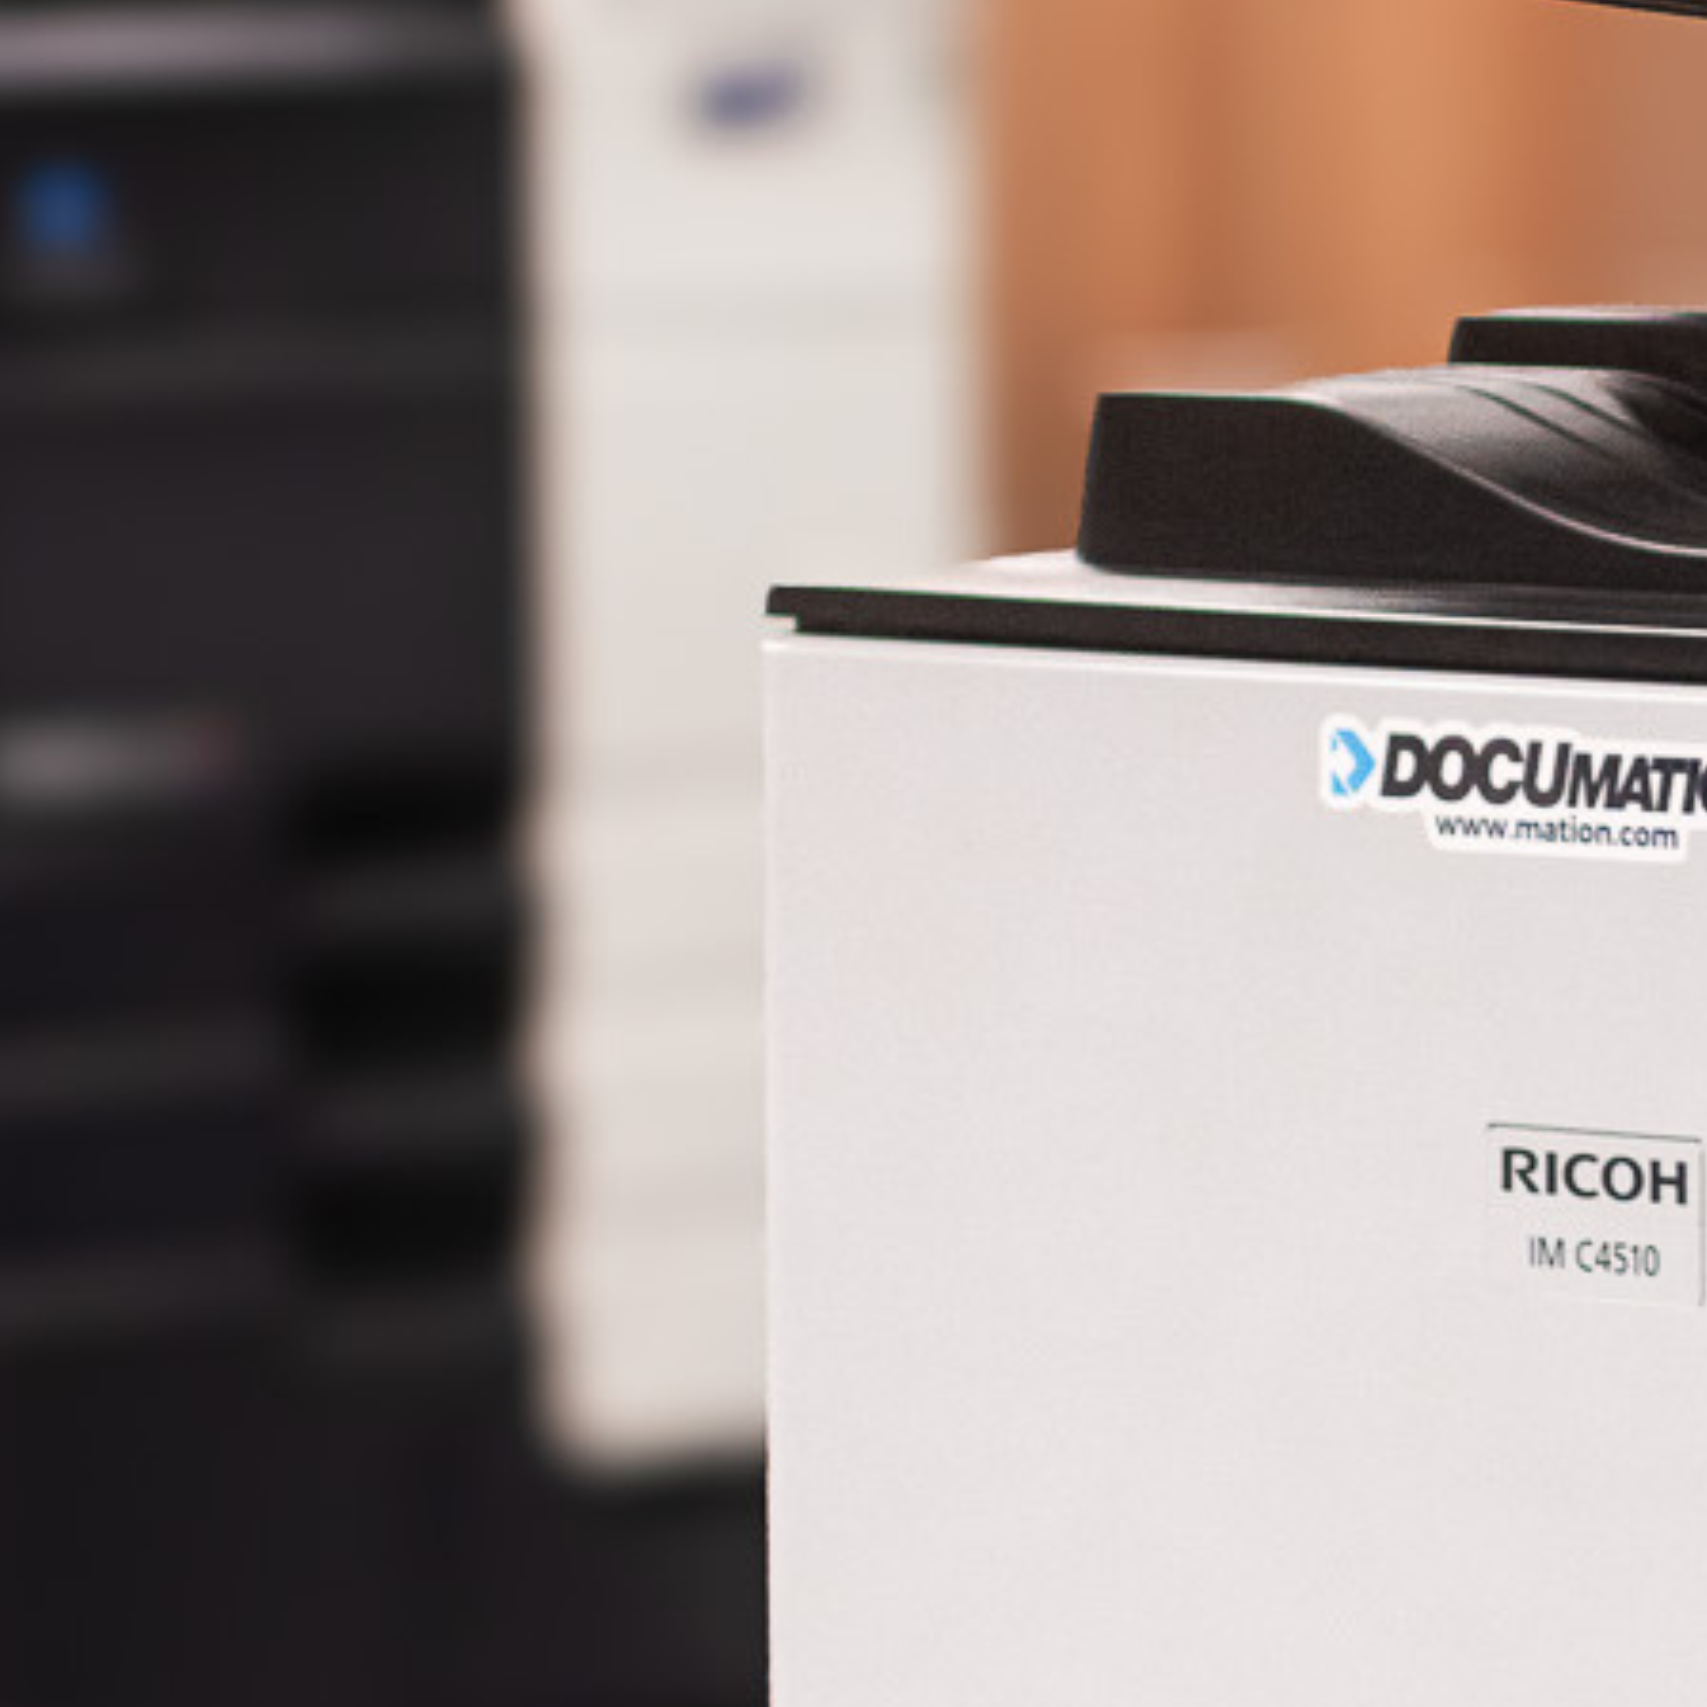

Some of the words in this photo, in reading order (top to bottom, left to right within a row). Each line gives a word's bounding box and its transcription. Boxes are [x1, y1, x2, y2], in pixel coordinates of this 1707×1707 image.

[1434, 814, 1679, 849] www.mation.com
[1500, 1146, 1688, 1205] RICOH
[1528, 1236, 1566, 1269] IM
[1575, 1239, 1661, 1278] C4510
